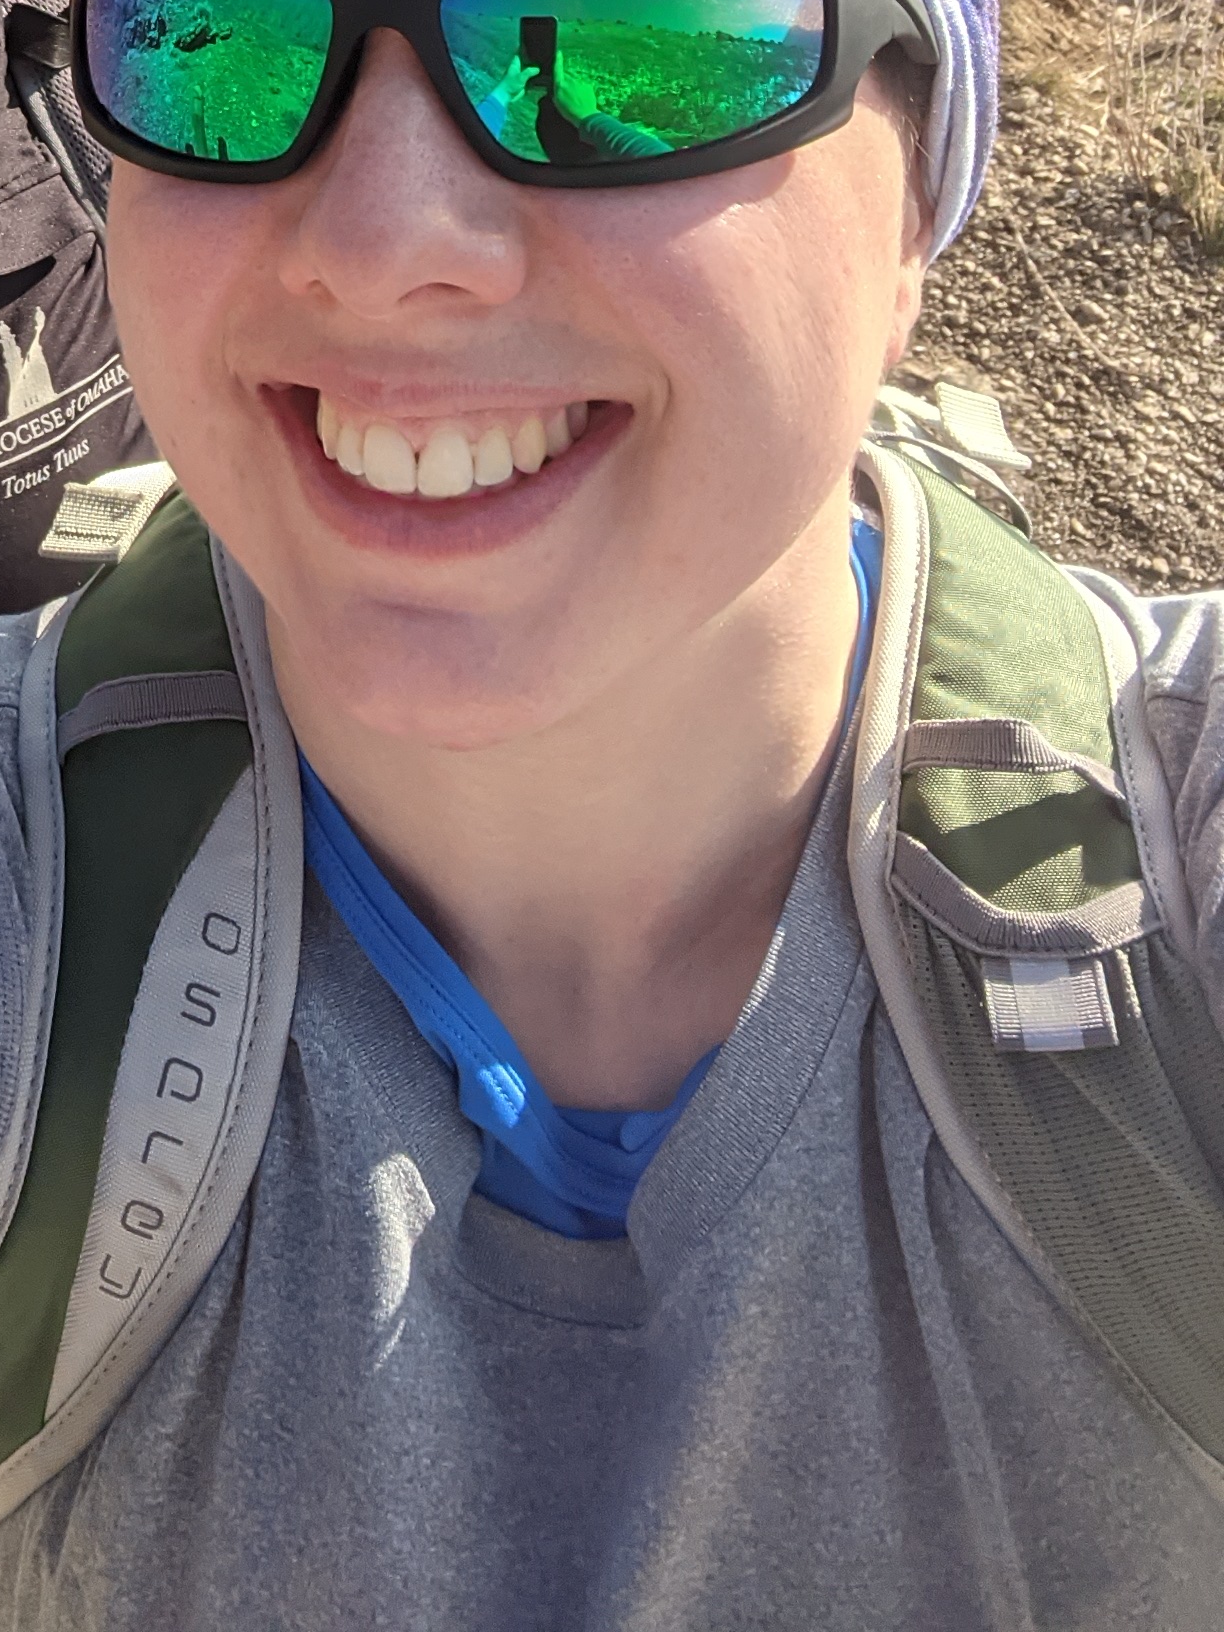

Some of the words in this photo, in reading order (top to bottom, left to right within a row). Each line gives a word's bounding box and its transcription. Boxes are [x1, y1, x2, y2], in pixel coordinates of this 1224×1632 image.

[65, 398, 77, 421] of
[77, 364, 130, 412] OMAHA
[1, 464, 51, 499] Totus
[53, 438, 90, 473] Tuus
